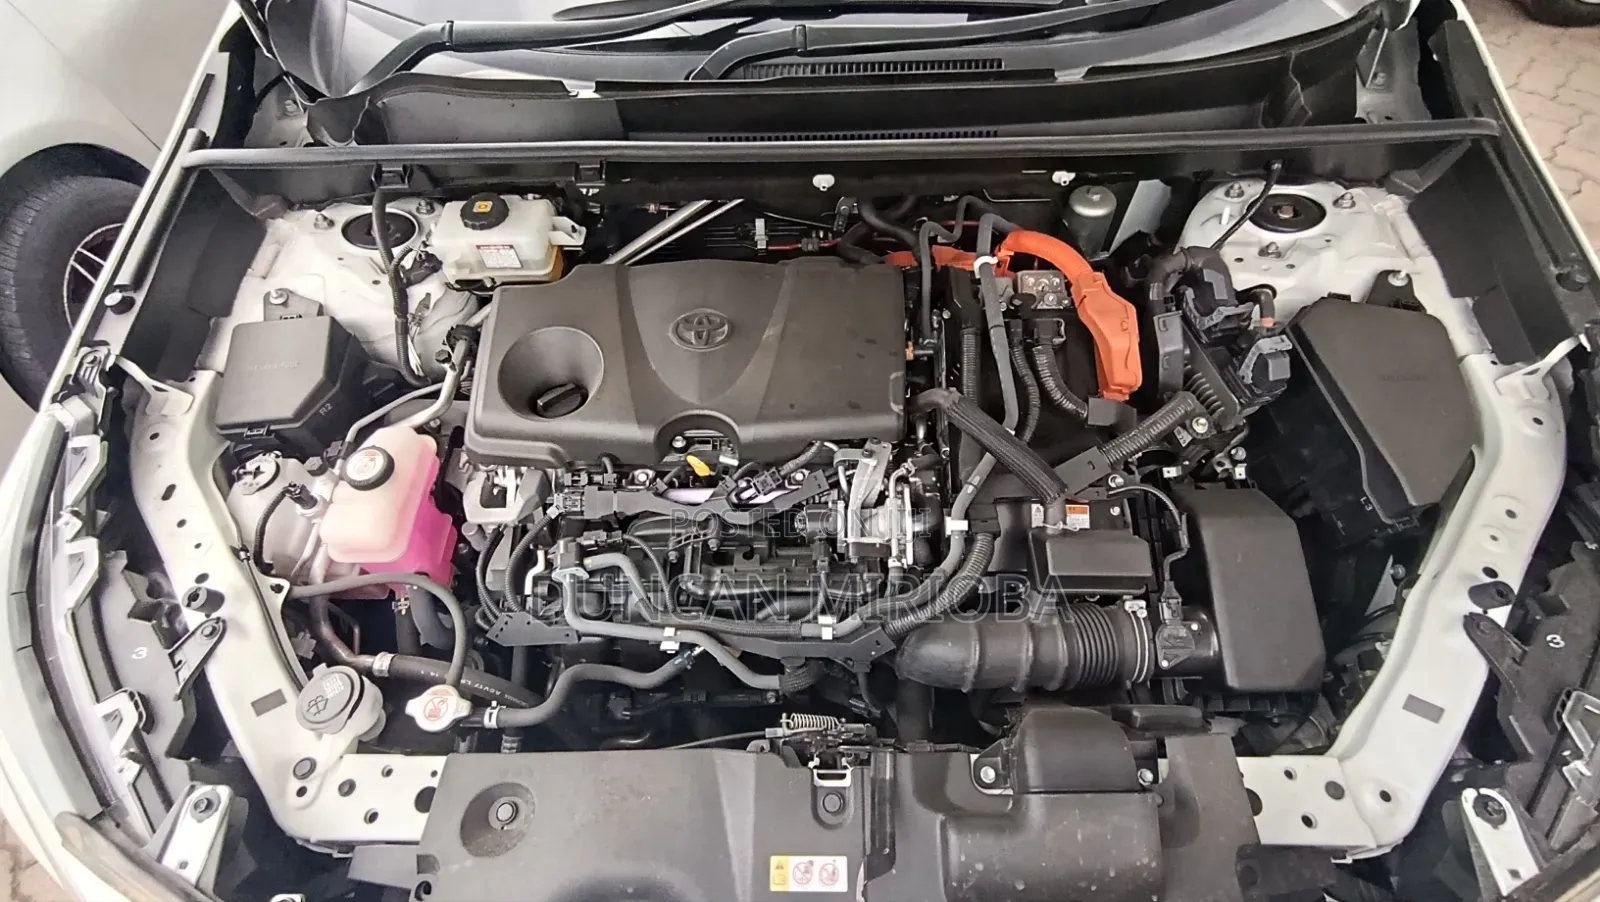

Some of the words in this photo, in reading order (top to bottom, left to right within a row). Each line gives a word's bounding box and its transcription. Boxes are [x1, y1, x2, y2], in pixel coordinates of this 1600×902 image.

[319, 403, 333, 416] R2
[1360, 496, 1373, 511] L3
[1546, 634, 1565, 648] 3
[131, 646, 148, 660] 3
